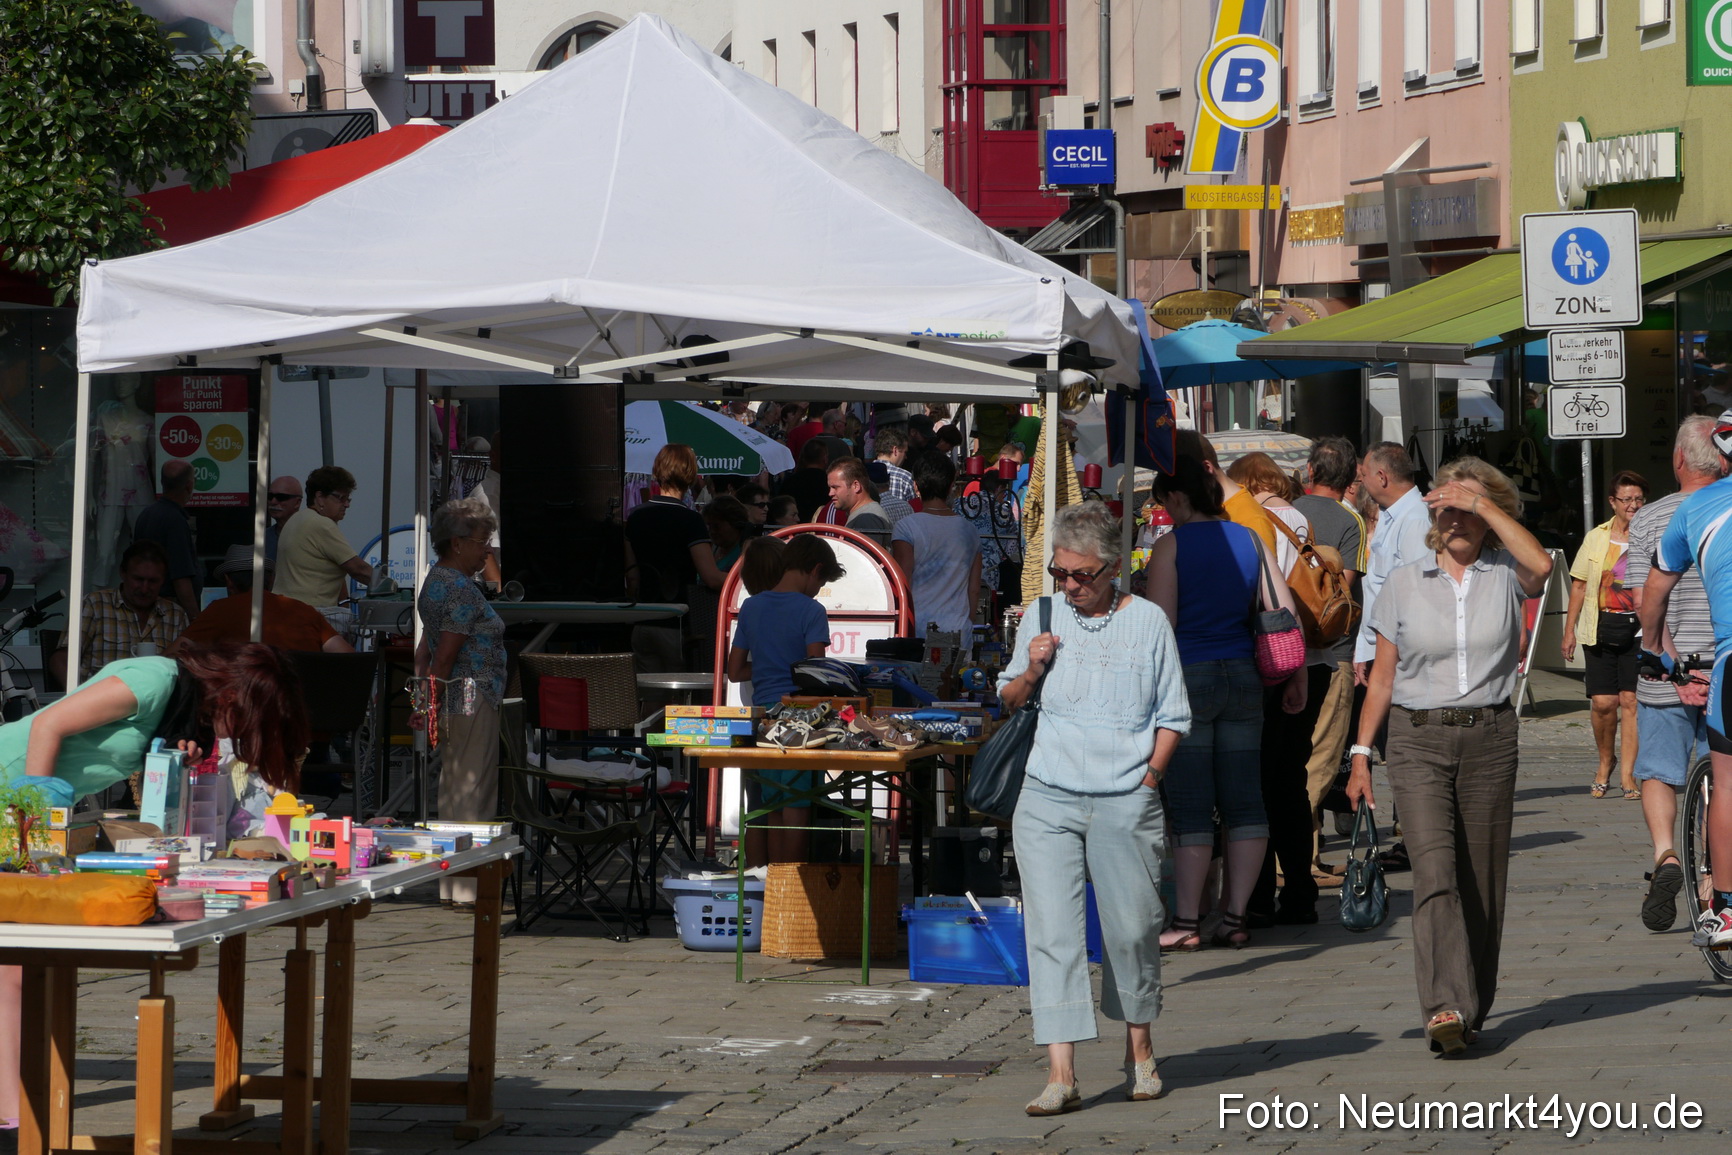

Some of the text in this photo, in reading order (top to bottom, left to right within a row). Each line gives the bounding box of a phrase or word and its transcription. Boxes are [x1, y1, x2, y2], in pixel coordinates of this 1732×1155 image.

[417, 1, 483, 57] T
[1221, 58, 1265, 102] B
[1052, 146, 1108, 162] CECIL
[1190, 192, 1275, 203] KLOSTERGASSE 4
[1157, 308, 1174, 316] DIE
[1578, 364, 1597, 375] frei
[183, 376, 222, 390] Punkt
[183, 390, 222, 399] für Punkt
[183, 399, 222, 411] sparen!
[1575, 419, 1599, 432] frei
[163, 429, 200, 444] -50%
[208, 437, 242, 450] -30%
